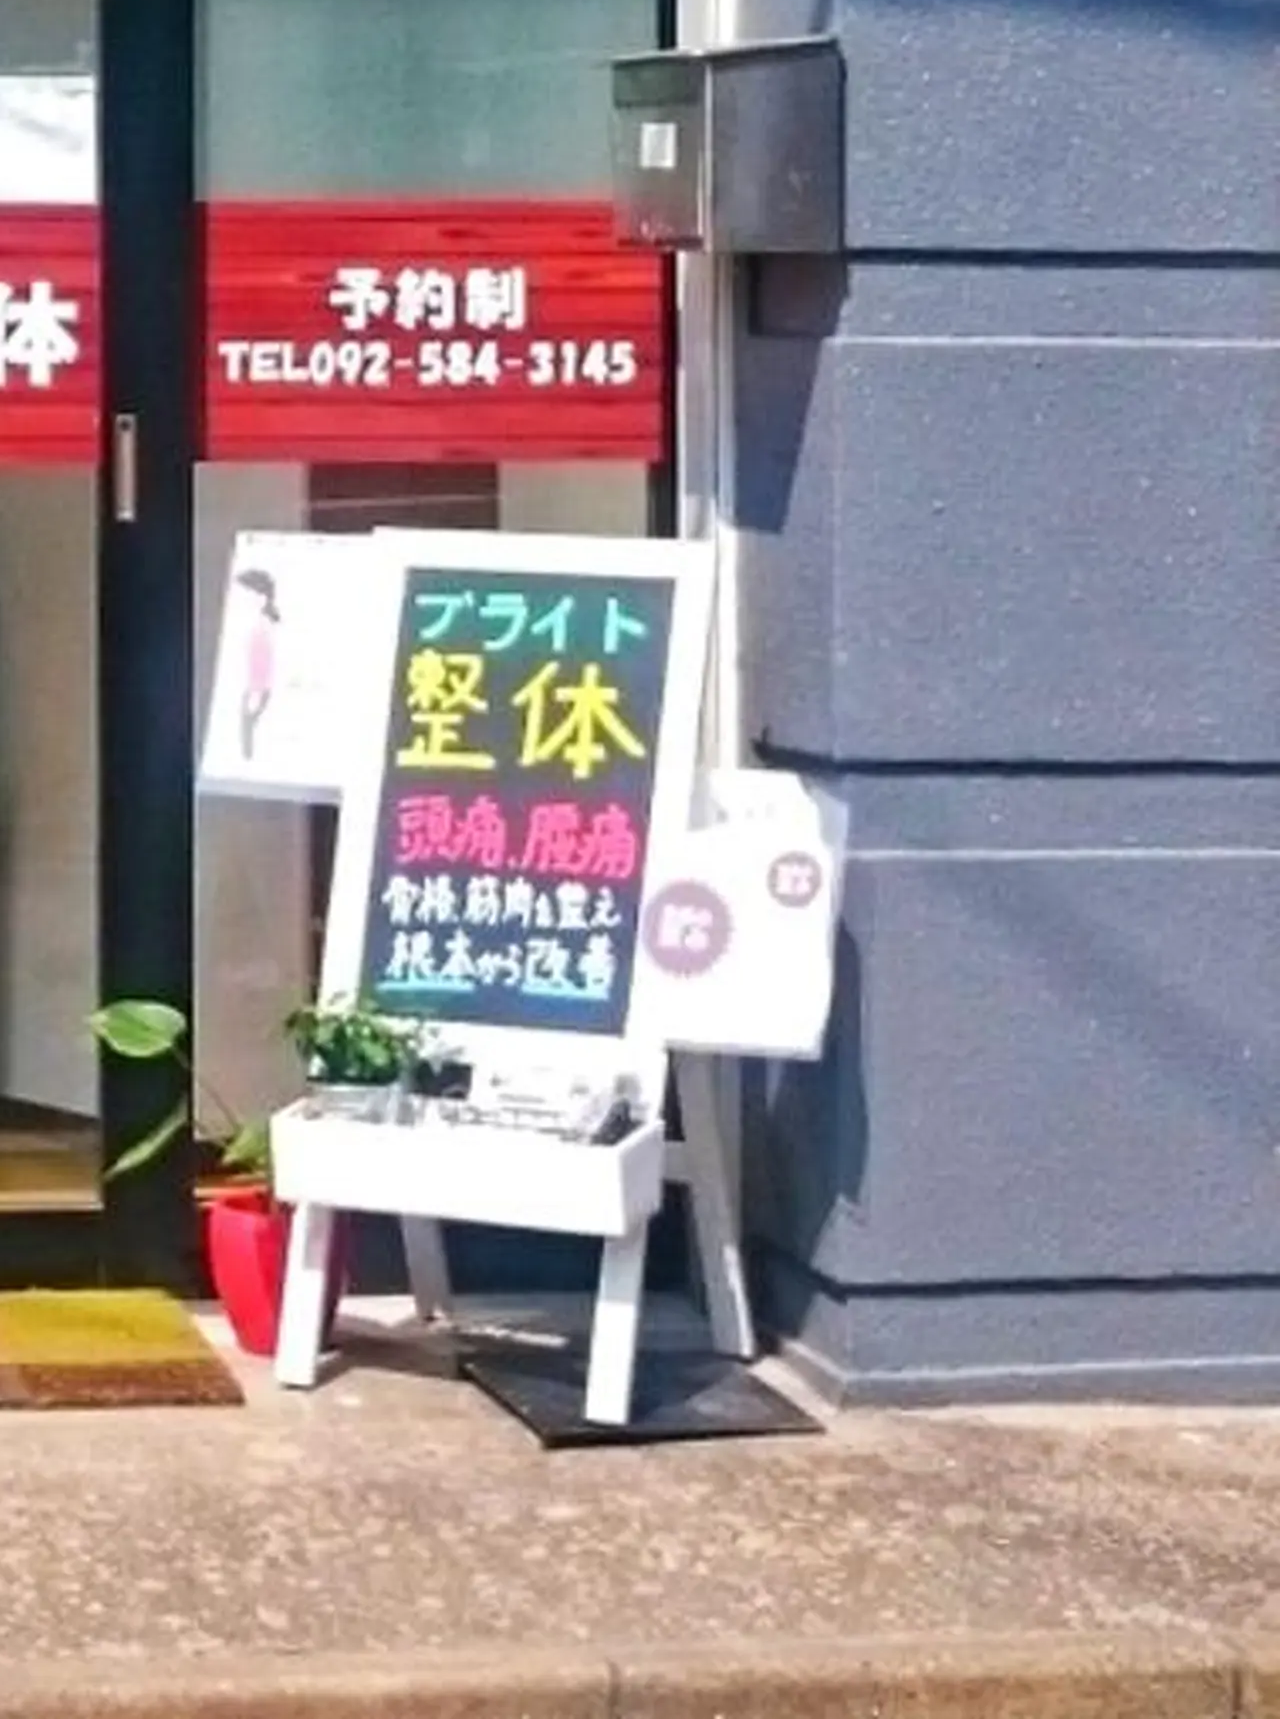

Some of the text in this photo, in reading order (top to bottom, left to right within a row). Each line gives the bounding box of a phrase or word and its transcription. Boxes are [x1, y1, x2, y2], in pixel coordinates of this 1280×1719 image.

[329, 266, 527, 331] 予約制
[217, 339, 638, 387] TEL092-584-3145
[412, 590, 647, 655] ブライト
[395, 647, 646, 780] 整体
